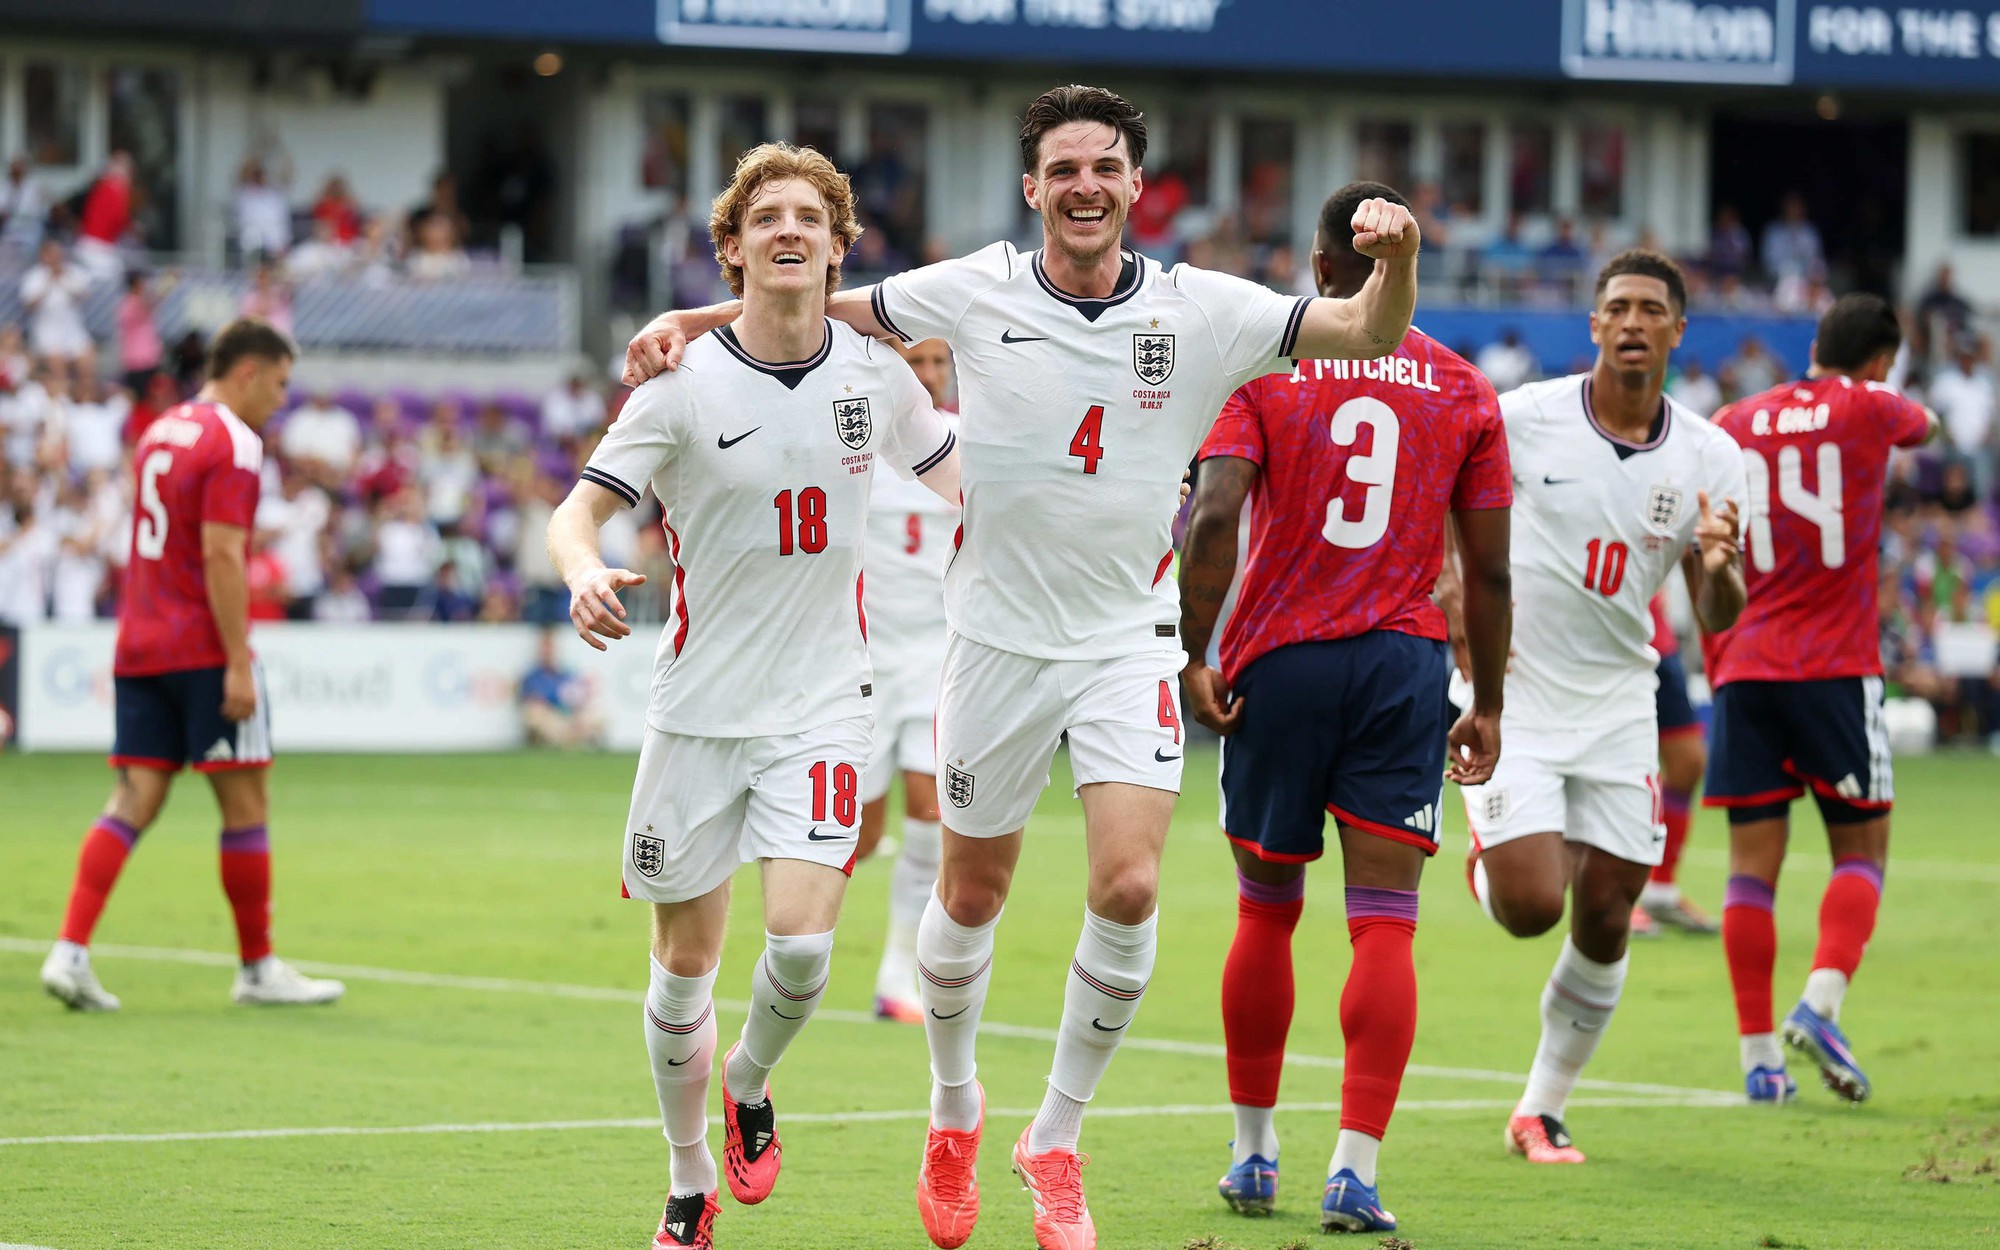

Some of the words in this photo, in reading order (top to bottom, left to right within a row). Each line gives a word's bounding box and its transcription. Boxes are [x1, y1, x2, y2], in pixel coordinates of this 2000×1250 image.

[1586, 0, 1773, 58] Hilton
[1809, 6, 1893, 55] FOR
[1896, 8, 1980, 58] THE
[1132, 389, 1156, 399] COSTA
[1157, 390, 1171, 399] RICA
[1314, 355, 1441, 392] MITCHELL
[841, 455, 861, 466] COSTA
[1069, 404, 1105, 475] 4
[1321, 395, 1400, 549] 3
[136, 449, 174, 561] 5
[773, 486, 828, 557] 18
[904, 513, 922, 555] 9
[1743, 443, 1845, 573] 14
[1584, 538, 1628, 597] 10
[1157, 680, 1180, 745] 4
[808, 760, 857, 828] 18
